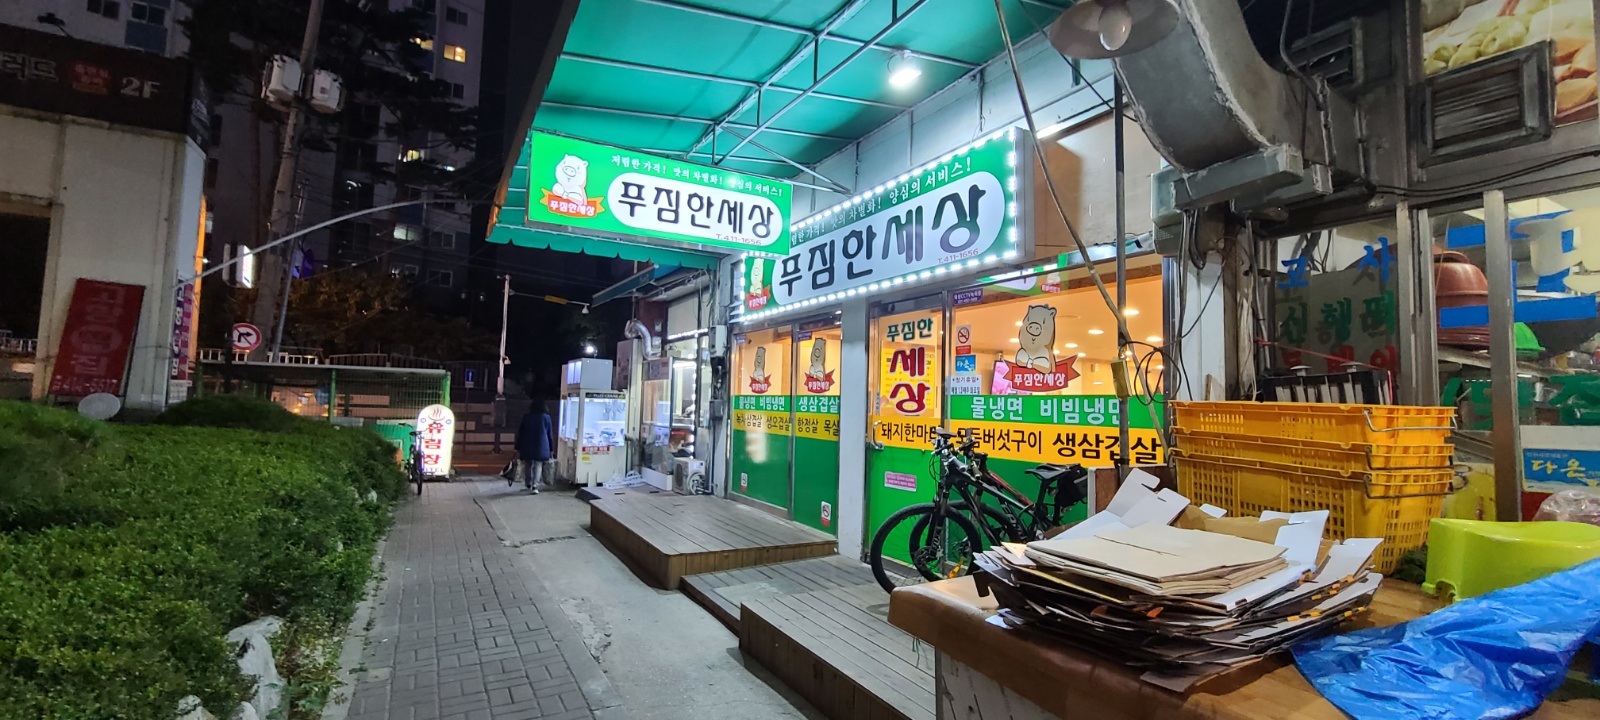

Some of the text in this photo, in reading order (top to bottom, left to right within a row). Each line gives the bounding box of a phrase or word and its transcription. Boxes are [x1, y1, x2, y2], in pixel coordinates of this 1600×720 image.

[120, 76, 161, 99] 2F
[611, 155, 640, 170] 저렴한
[643, 161, 667, 175] 가격!
[673, 167, 690, 179] 맛의
[693, 171, 723, 185] 차별화!
[755, 183, 783, 197] 서비스!
[550, 200, 595, 216] 푸짐한세상
[618, 181, 774, 239] 푸짐한세상
[791, 230, 804, 246] 렴한
[849, 197, 881, 220] 차별화!
[889, 179, 921, 204] 양심의
[925, 156, 971, 188] 서비스!
[715, 233, 762, 246] T.411-1656
[779, 183, 987, 297] 푸짐한세상
[937, 248, 979, 265] T.411-1656
[886, 318, 933, 342] 푸짐한
[889, 346, 930, 413] 세상
[1014, 372, 1065, 387] 푸짐한세상
[759, 396, 785, 411] 비빔냉면
[798, 396, 839, 413] 생삼겹살
[970, 397, 1023, 421] 물냉면
[797, 417, 818, 434] 항정살
[424, 422, 445, 466] 유림장
[1531, 459, 1586, 478] 다온
